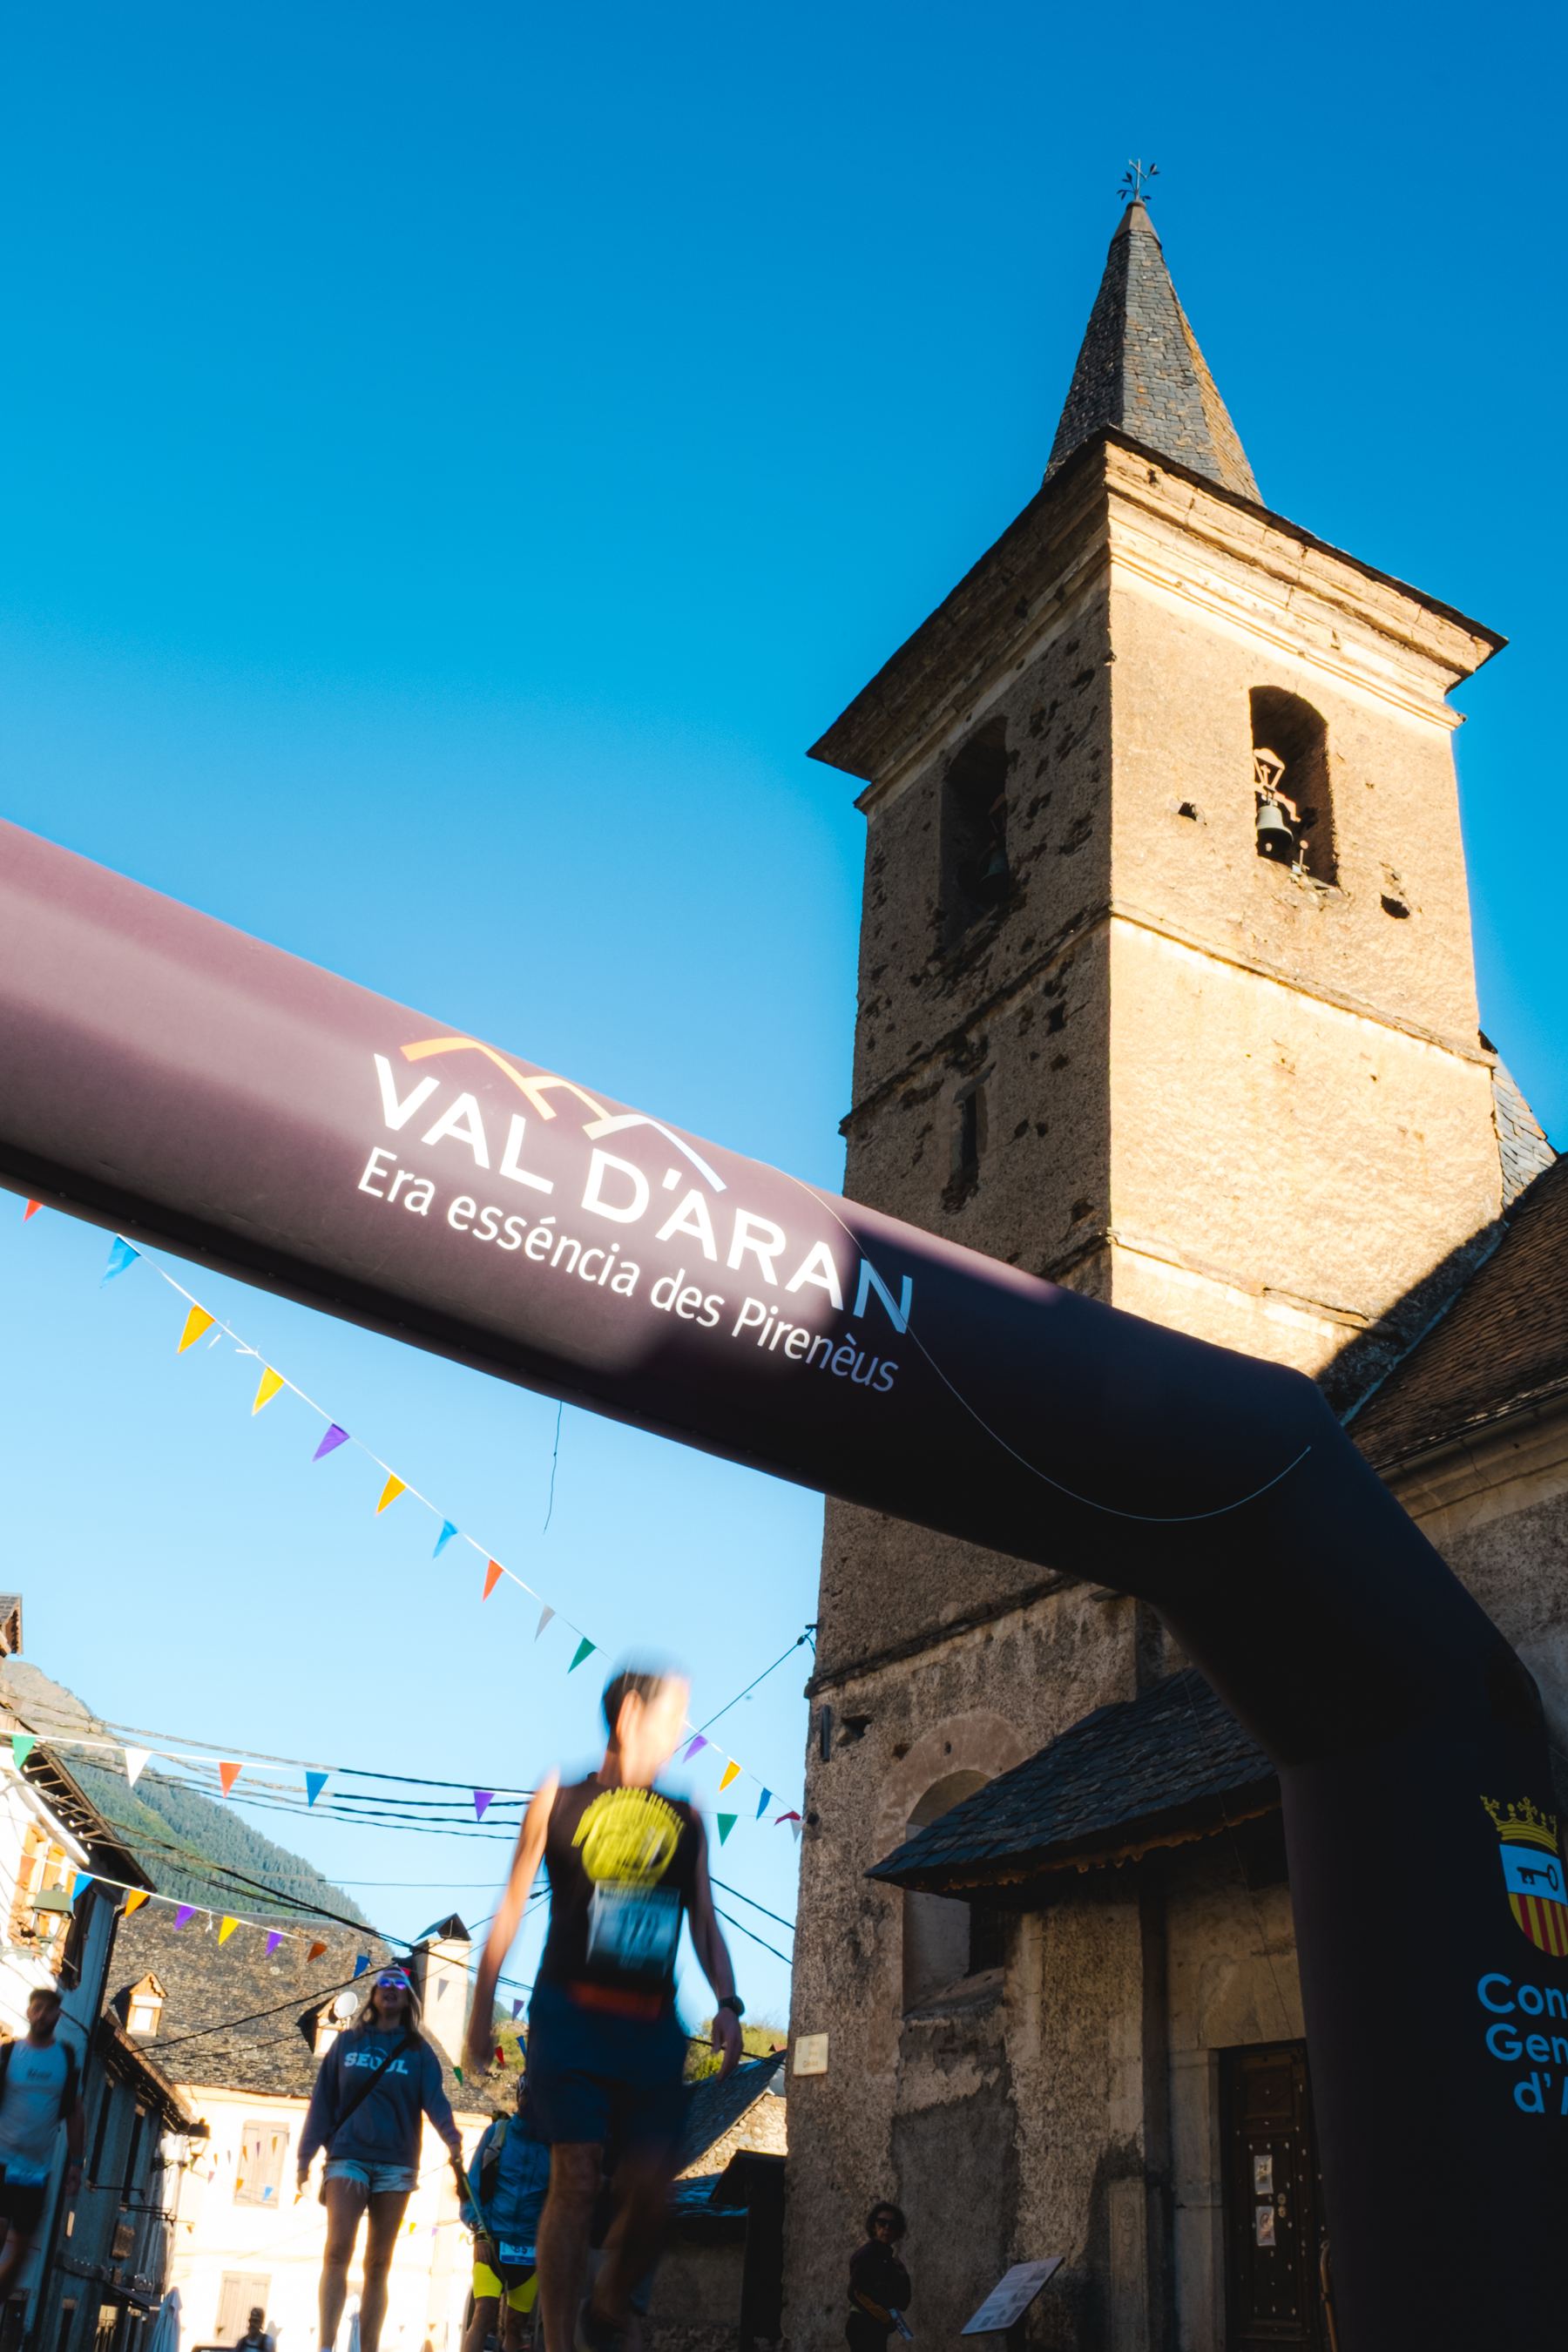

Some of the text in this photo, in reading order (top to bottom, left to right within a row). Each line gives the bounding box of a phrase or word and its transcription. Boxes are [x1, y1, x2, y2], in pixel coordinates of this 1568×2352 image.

[374, 1053, 913, 1334] VAL D'ARAN
[358, 1147, 898, 1392] Era esséncia des Pirenèus
[1478, 1973, 1568, 2019] Con
[1514, 2072, 1568, 2115] d'
